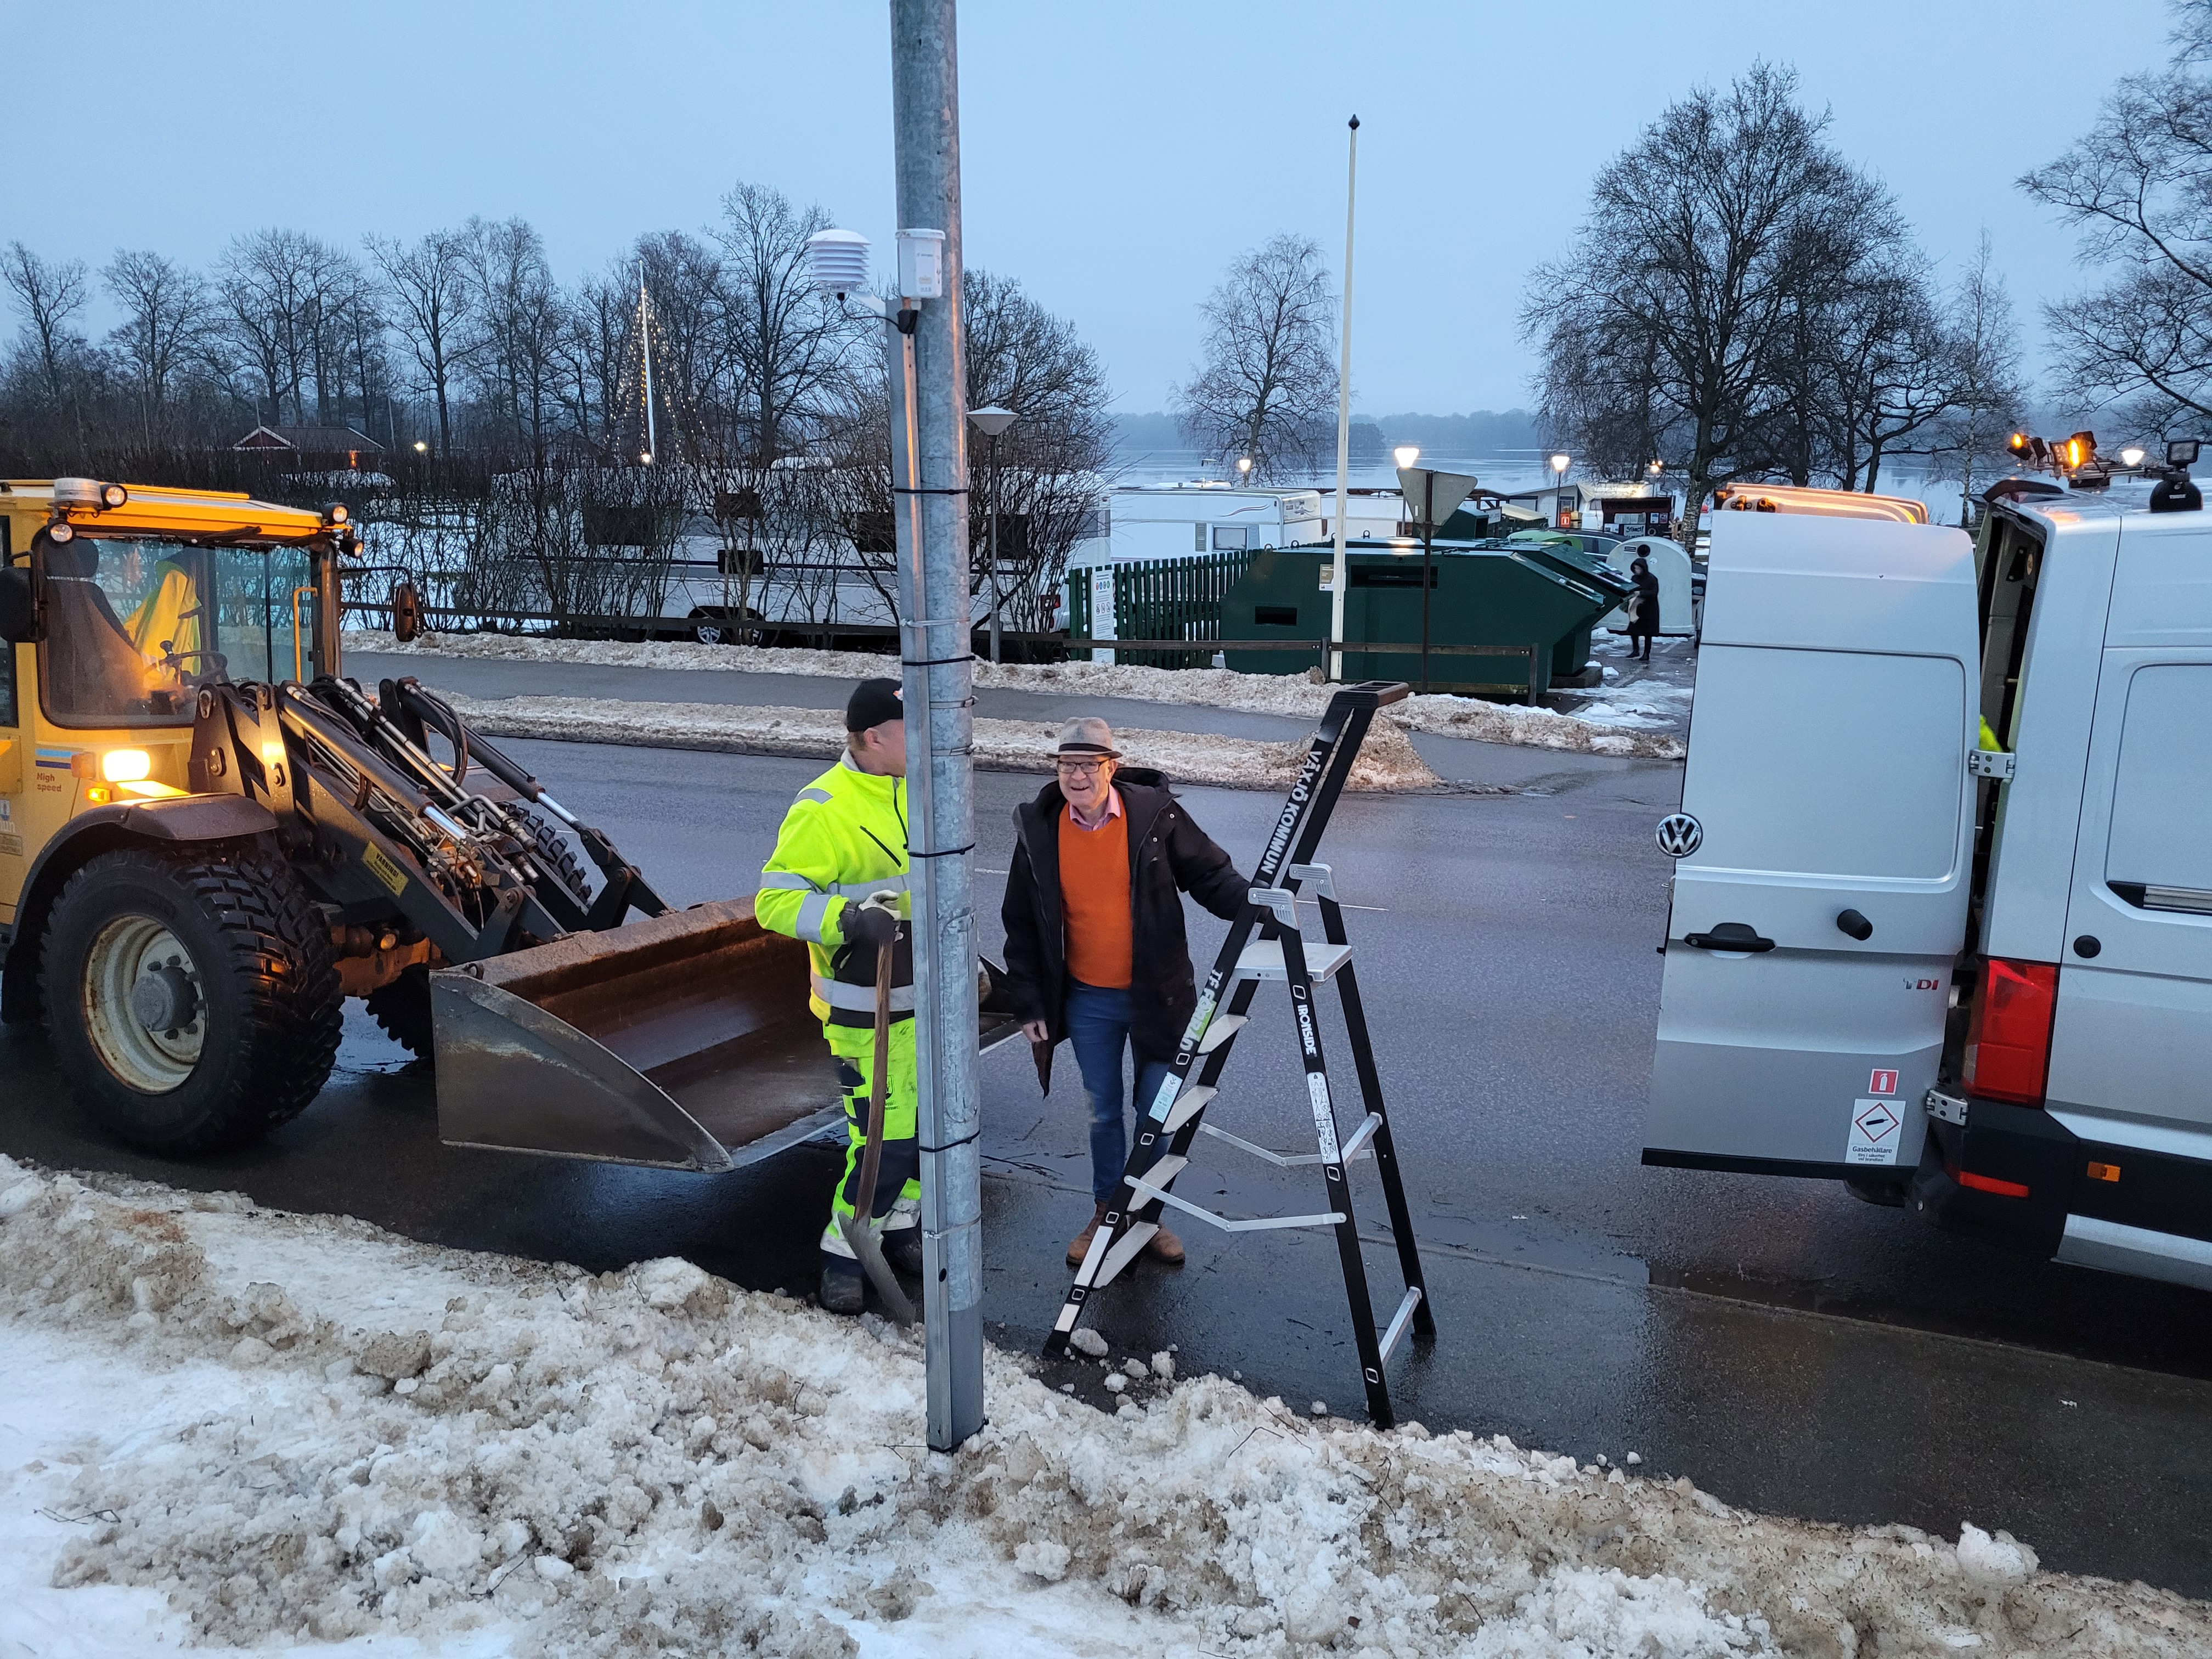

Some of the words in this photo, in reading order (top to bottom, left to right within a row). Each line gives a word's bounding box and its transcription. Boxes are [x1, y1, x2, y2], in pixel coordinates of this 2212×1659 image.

[37, 772, 55, 783] High
[37, 784, 61, 792] speed
[1291, 751, 1323, 802] VÄXJÖ
[1261, 802, 1300, 875] KOMMUN
[376, 853, 399, 878] VARNING!
[1903, 978, 1939, 990] TDI
[1297, 1005, 1316, 1056] IRONSIDE
